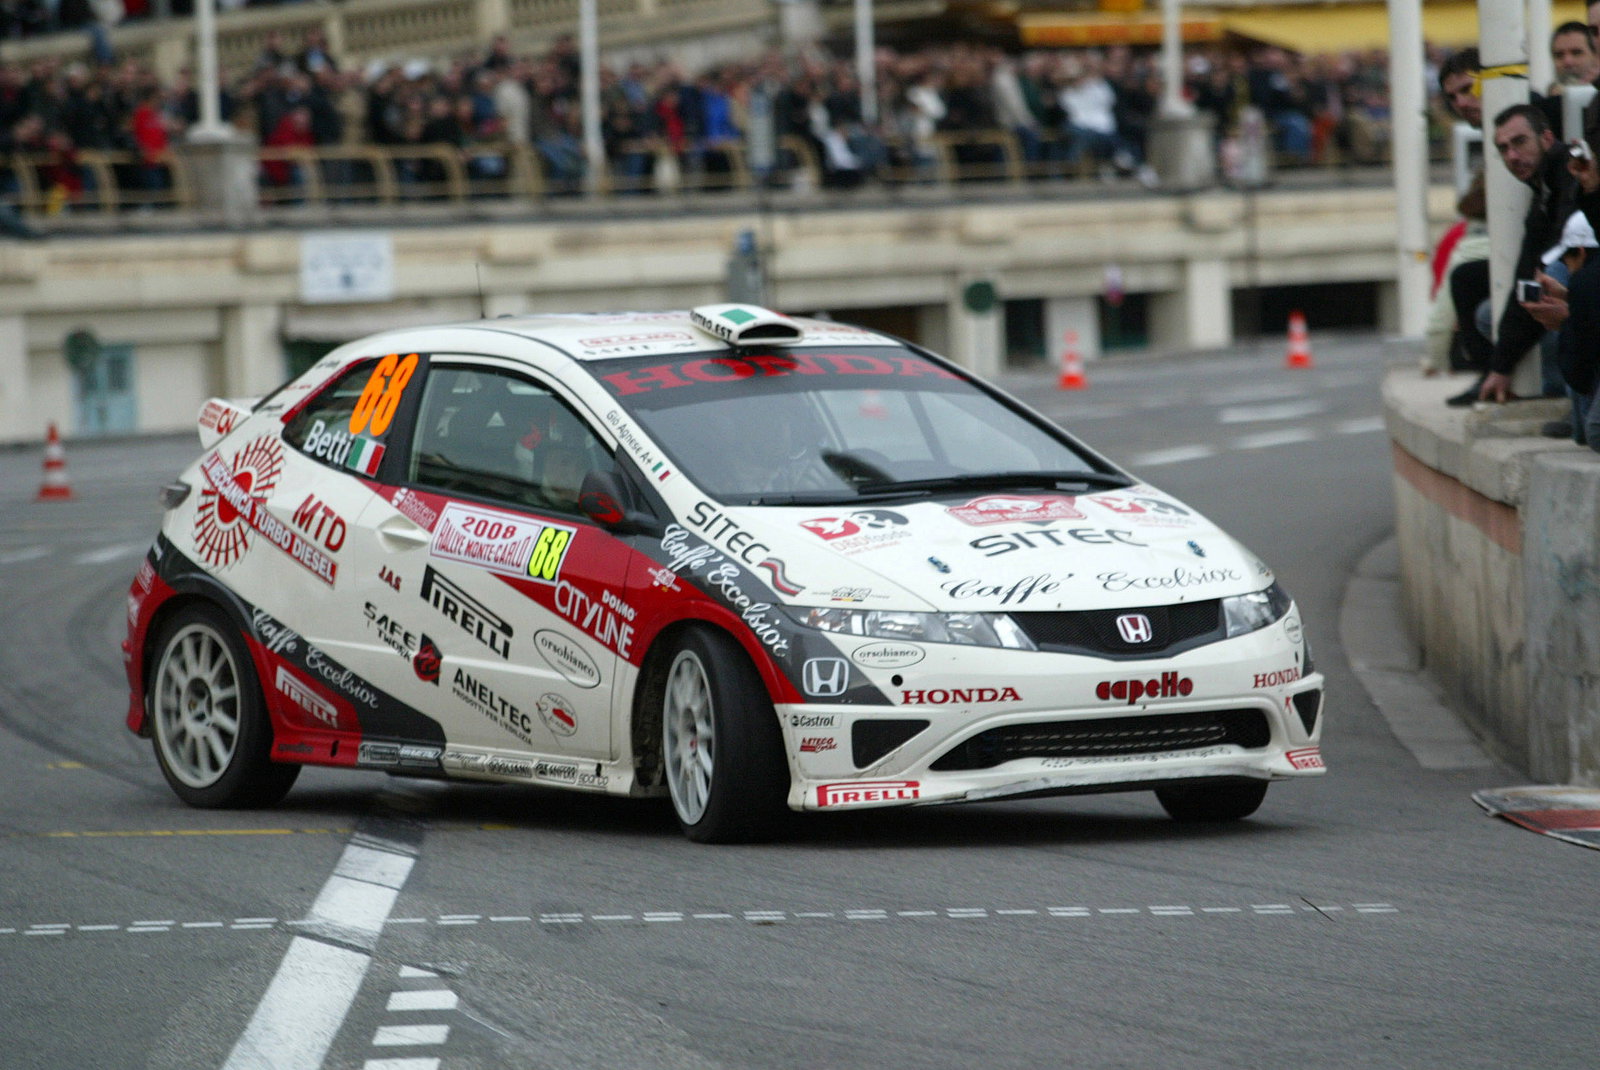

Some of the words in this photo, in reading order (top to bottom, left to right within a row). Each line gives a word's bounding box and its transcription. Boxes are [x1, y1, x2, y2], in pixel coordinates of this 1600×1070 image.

[349, 353, 418, 437] 68
[602, 353, 970, 396] HONDA
[303, 420, 355, 465] Betti
[617, 424, 643, 455] Agnese
[210, 463, 254, 519] MECCANICA
[253, 506, 293, 550] TURBO
[292, 539, 334, 582] DIESEL
[292, 493, 346, 552] MTD
[435, 518, 467, 557] RALLYE
[464, 535, 531, 568] MONTE-CARLO
[462, 516, 517, 540] 2008
[686, 501, 770, 564] SITEC
[969, 528, 1149, 557] SITEC
[529, 527, 569, 580] 68
[378, 565, 401, 592] JAS
[1097, 567, 1242, 592] Excelsior
[363, 601, 417, 652] SAFE
[420, 564, 513, 660] PIRELLI
[554, 579, 634, 659] CITYLINE
[601, 589, 635, 622] DOIMO
[707, 562, 788, 657] Excelsior
[541, 637, 595, 678] orsobianco
[858, 648, 919, 660] orsobianco
[276, 665, 338, 728] PIRELLI
[306, 645, 379, 709] Excelsior
[901, 687, 1023, 705] HONDA
[1252, 667, 1301, 689] HONDA
[452, 687, 484, 715] PRODOTTI
[485, 709, 498, 723] PER
[453, 667, 532, 735] ANELTEC
[800, 715, 835, 727] Castrol
[817, 780, 920, 807] PIRELLI
